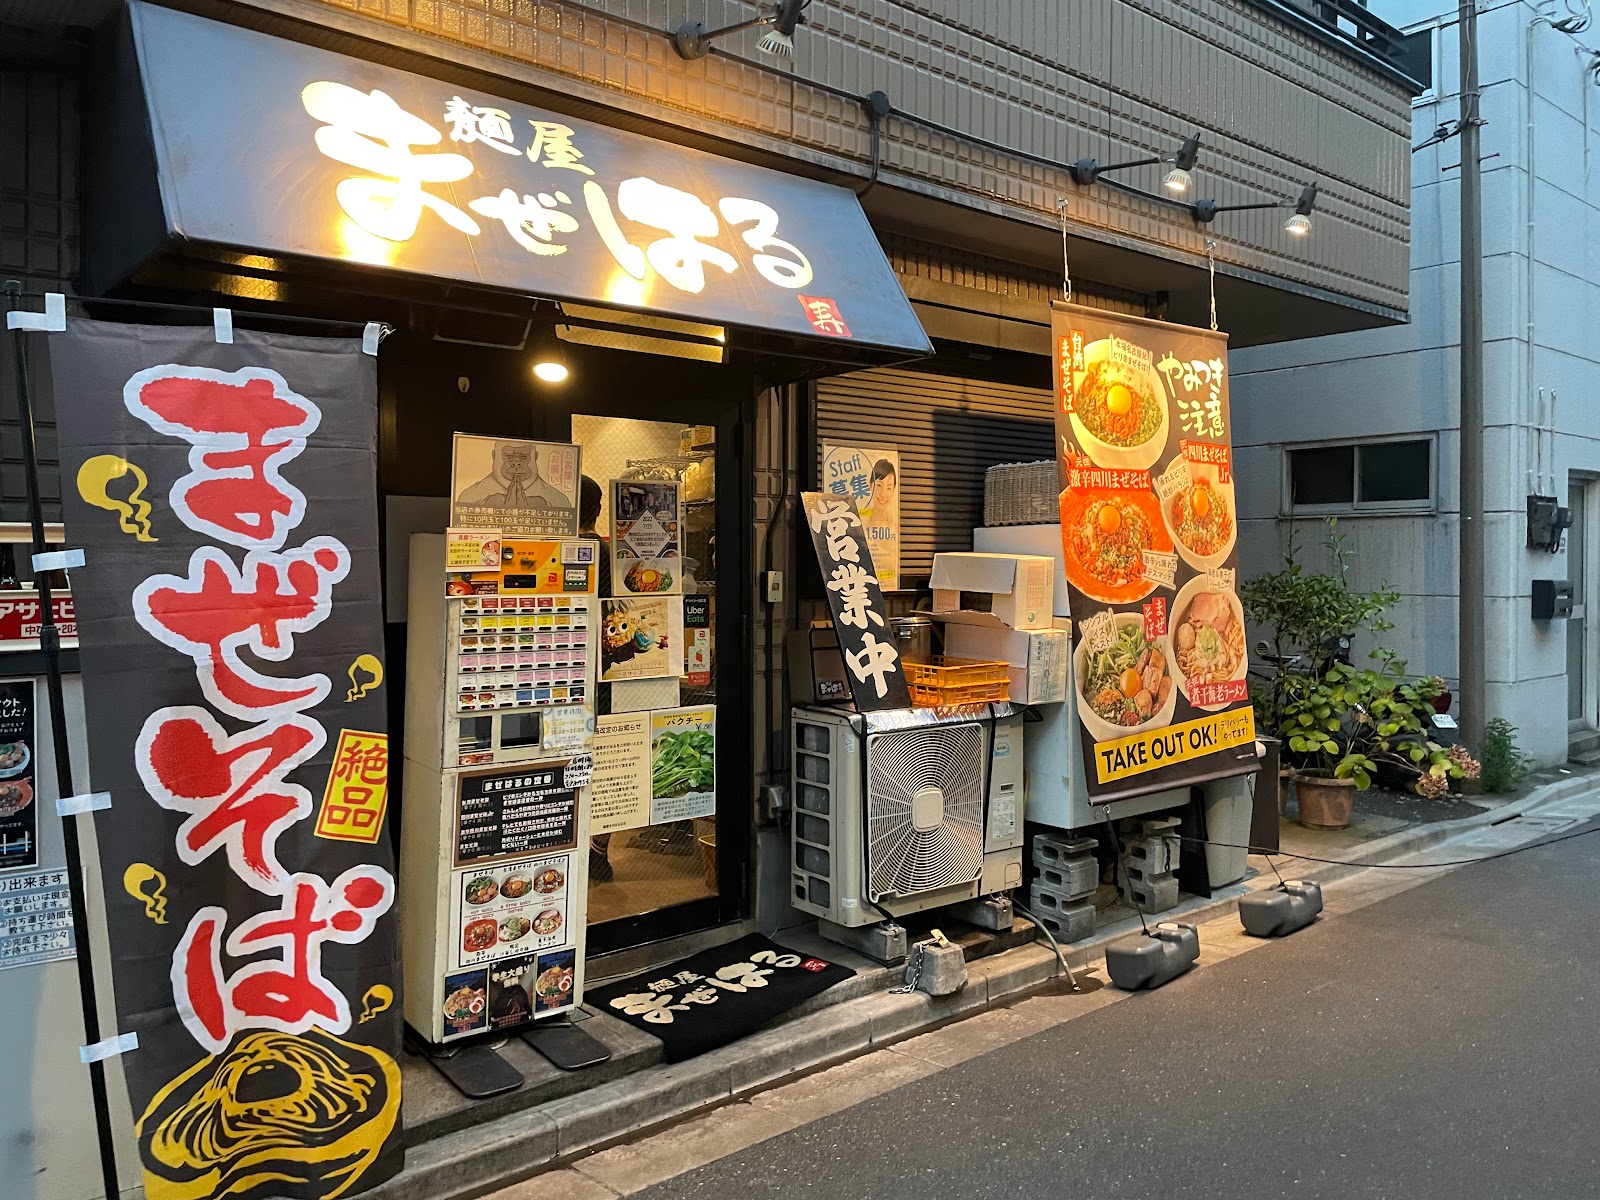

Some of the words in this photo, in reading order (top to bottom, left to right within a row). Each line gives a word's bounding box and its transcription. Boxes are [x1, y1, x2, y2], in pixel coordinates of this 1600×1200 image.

[1061, 338, 1074, 411] まぜそば
[1157, 351, 1225, 397] やみつき
[1177, 396, 1225, 438] 注意
[829, 453, 862, 477] Staff
[1188, 445, 1228, 463] 四川まぜそば
[1070, 469, 1150, 489] 激辛四川まぜそば
[686, 606, 705, 614] Uber
[811, 500, 898, 699] 営業中
[686, 615, 705, 623] Eats
[1145, 606, 1155, 639] そば
[1156, 599, 1166, 634] まぜ
[0, 707, 27, 718] した!
[123, 364, 395, 1054] まぜそば
[666, 717, 703, 726] パクチー
[1101, 742, 1148, 774] TAKE
[1151, 732, 1185, 760] OUT
[1189, 723, 1218, 750] OK!
[328, 741, 387, 827] 絶品
[0, 891, 70, 905] お支払いは現金
